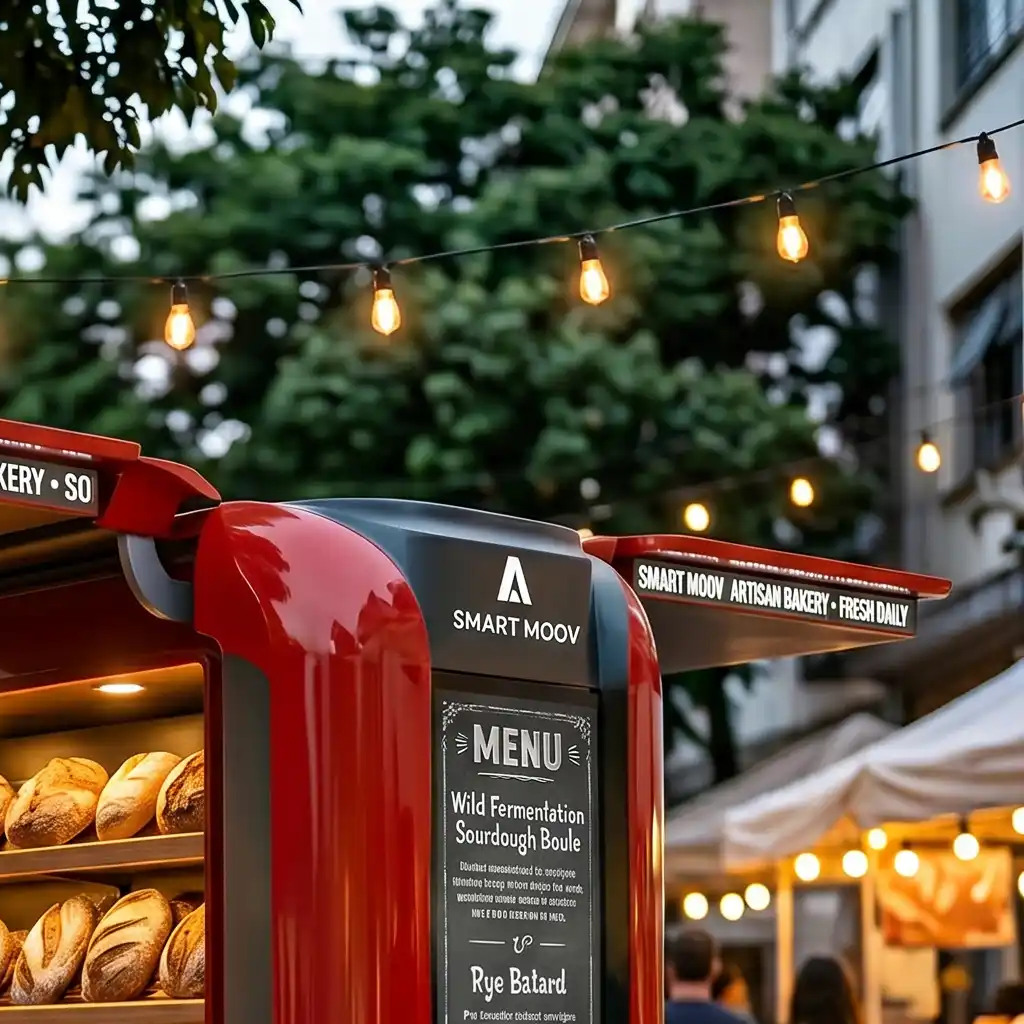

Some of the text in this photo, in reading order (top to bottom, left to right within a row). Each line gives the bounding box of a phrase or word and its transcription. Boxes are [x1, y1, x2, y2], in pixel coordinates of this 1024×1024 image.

[65, 473, 91, 502] SO
[639, 565, 908, 627] SMART MOOV ARTISAN BAKERY FRESH DAILY
[454, 610, 580, 644] SMART MOOV
[474, 724, 561, 770] MENU
[451, 791, 584, 824] Wild Fermentation
[456, 820, 580, 856] Sourdough Boule
[471, 966, 566, 1002] Rye Batard
